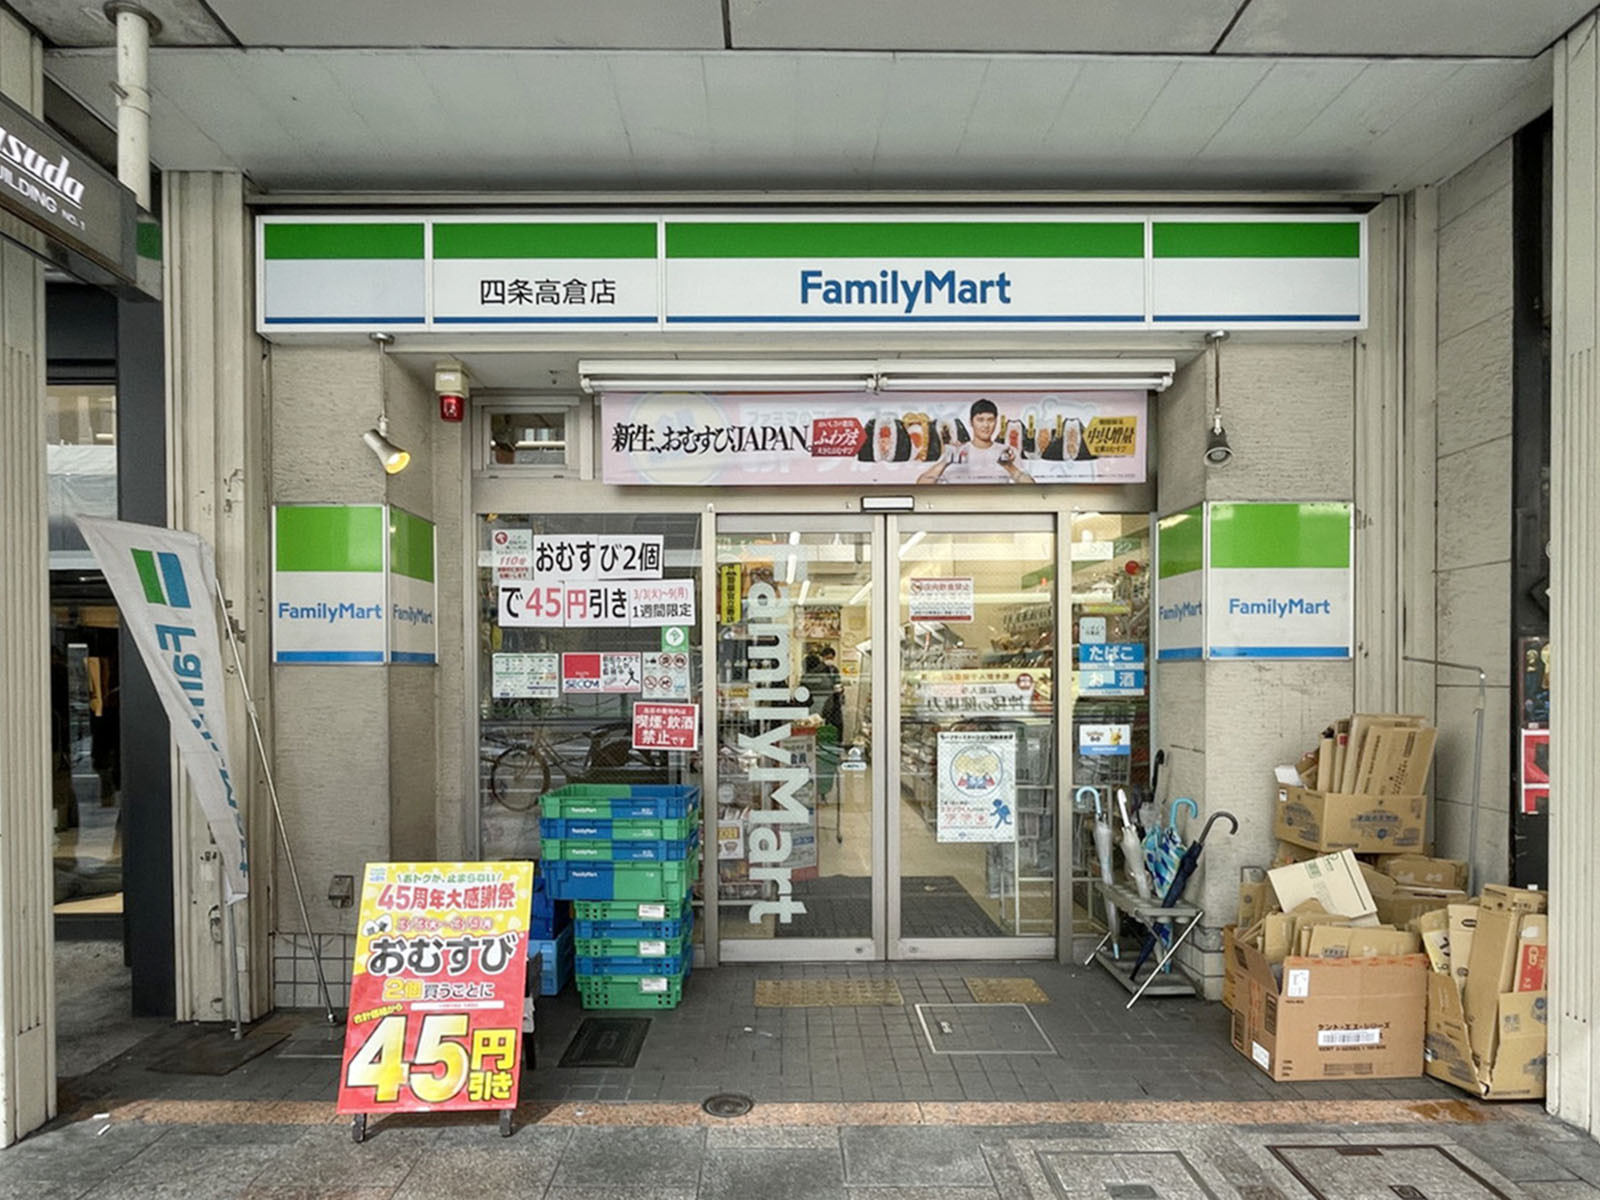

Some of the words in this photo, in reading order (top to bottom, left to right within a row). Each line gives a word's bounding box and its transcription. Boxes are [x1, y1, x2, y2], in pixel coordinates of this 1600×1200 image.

[479, 278, 616, 306] 四条高倉店
[799, 269, 1012, 314] FamilyMart
[536, 541, 660, 572] おむすび2個
[278, 602, 382, 623] FamilyMart
[501, 587, 627, 618] で45円引き
[632, 603, 692, 618] 1週間限定
[1159, 601, 1202, 622] FamilyMart
[1229, 598, 1331, 618] FamilyMart
[392, 604, 433, 626] FamilyMart
[1089, 646, 1134, 662] たばこ
[565, 679, 600, 689] SECOM
[636, 715, 694, 730] 喫煙・飲酒
[641, 730, 687, 746] 禁止です
[738, 543, 811, 924] FamilyMart
[377, 882, 516, 911] 45周年大感謝祭
[370, 935, 518, 974] おむすび
[385, 979, 495, 998] 2個買うことに
